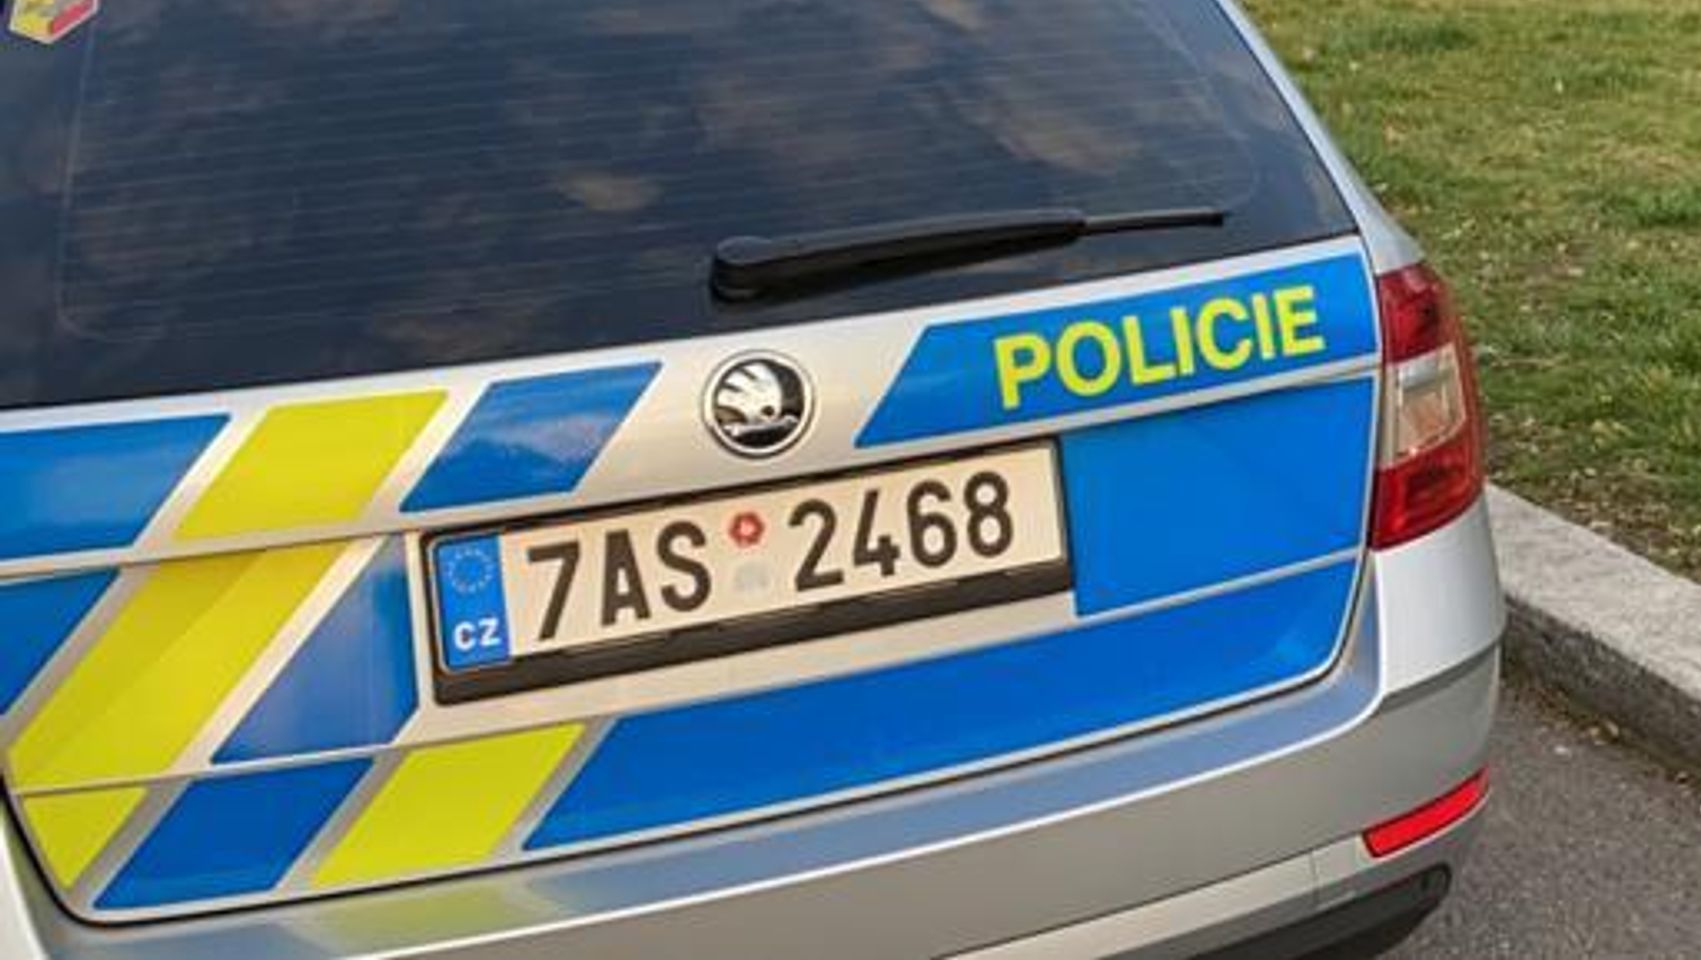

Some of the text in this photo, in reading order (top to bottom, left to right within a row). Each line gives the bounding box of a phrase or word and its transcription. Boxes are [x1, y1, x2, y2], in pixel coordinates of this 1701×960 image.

[993, 284, 1325, 410] POLICIE
[527, 470, 1014, 640] 7AS 2468
[453, 618, 501, 651] CZ
